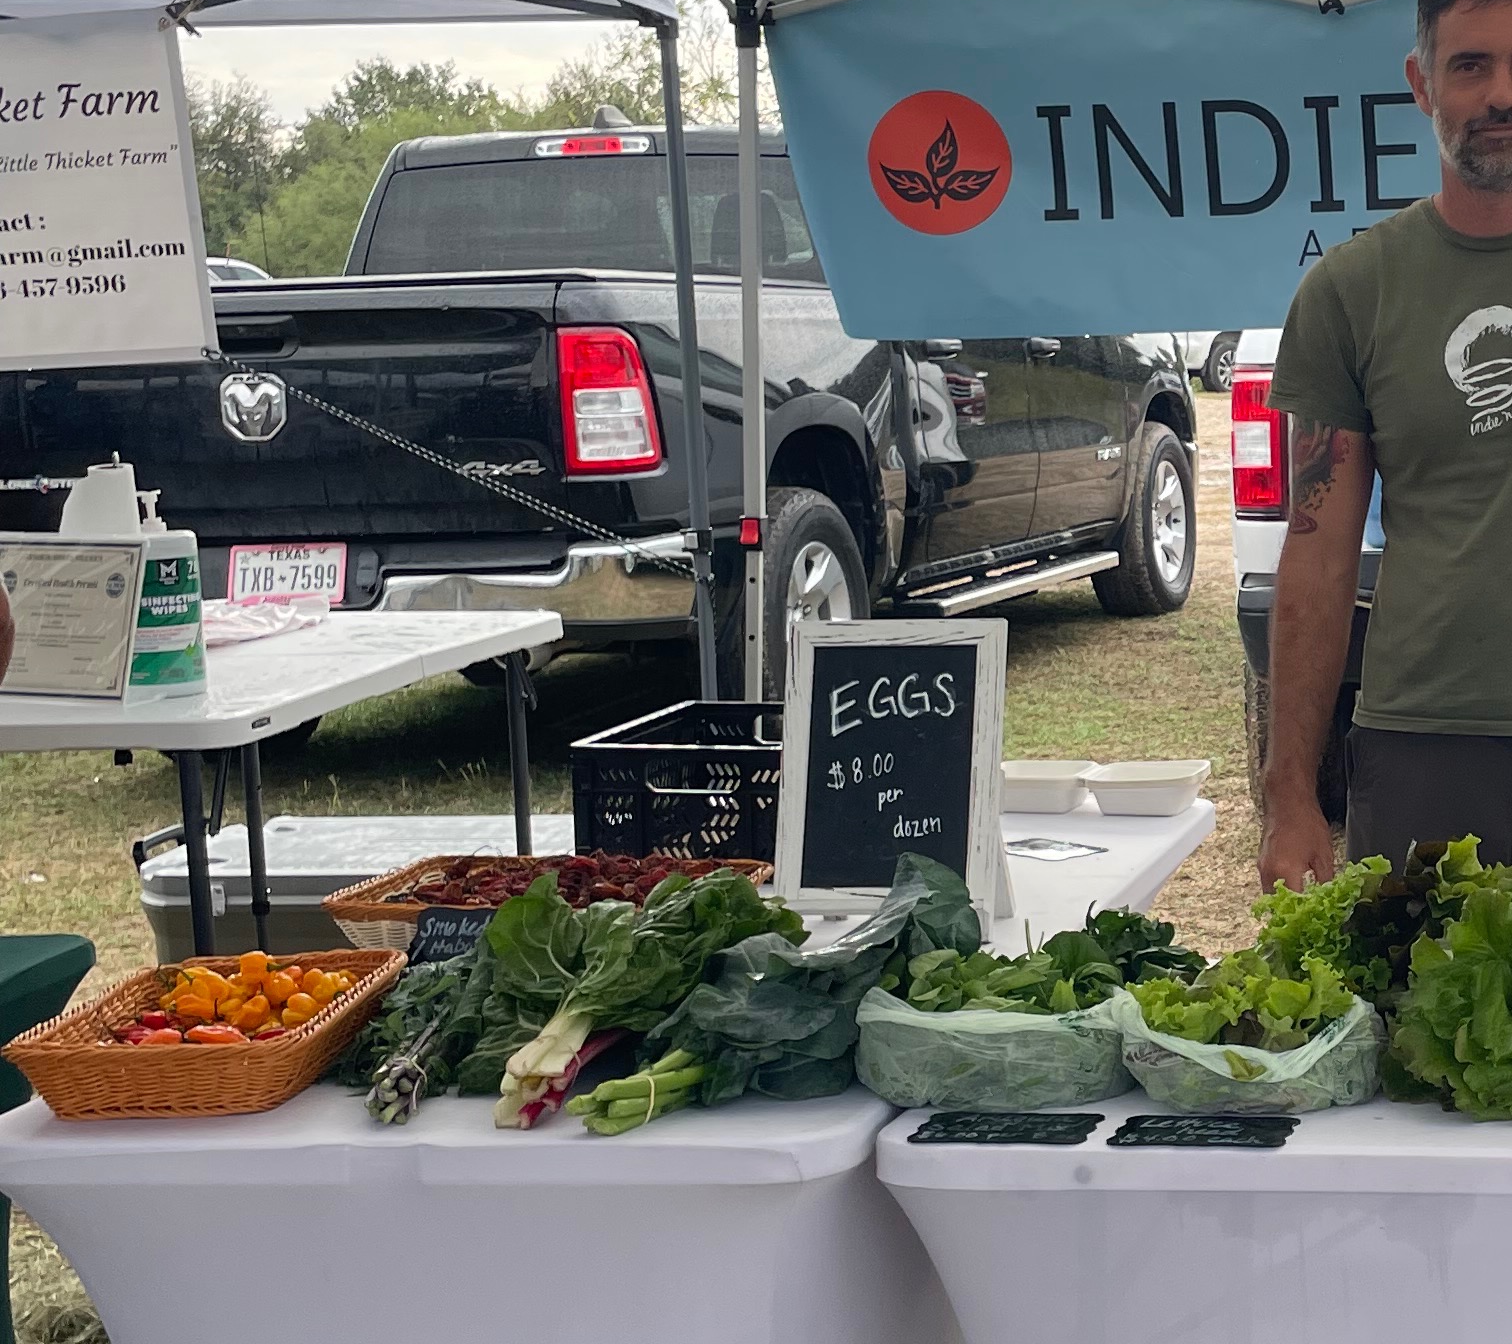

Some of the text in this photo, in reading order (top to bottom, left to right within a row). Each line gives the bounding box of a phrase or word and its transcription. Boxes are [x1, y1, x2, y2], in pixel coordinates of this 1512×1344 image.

[57, 82, 160, 118] Farm
[45, 149, 114, 171] Thicket
[1036, 92, 1426, 222] INDIE
[1299, 229, 1324, 267] A
[268, 548, 311, 562] TEXAS
[151, 604, 189, 616] WIPES
[829, 673, 957, 738] EGGS
[826, 753, 895, 790] $8.00
[878, 787, 904, 812] per
[893, 814, 942, 839] dozen
[420, 914, 492, 938] Smoked
